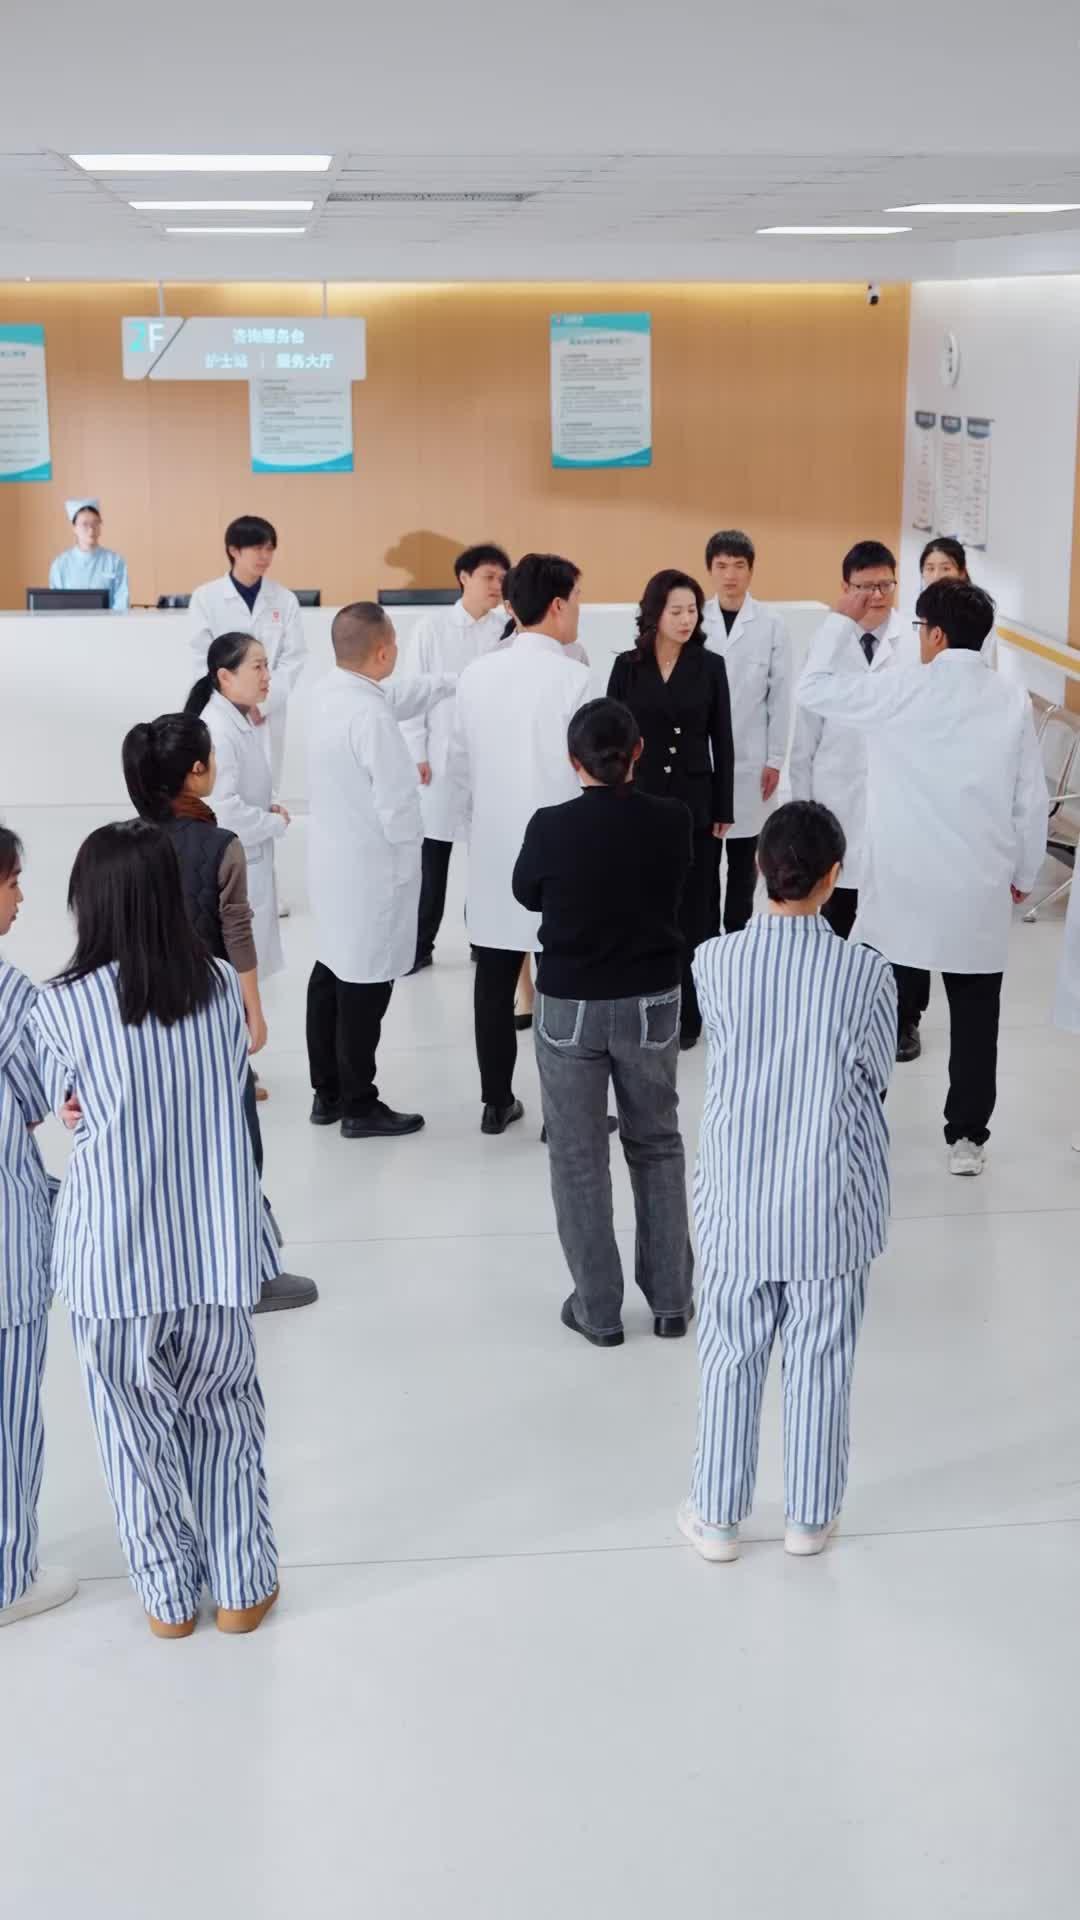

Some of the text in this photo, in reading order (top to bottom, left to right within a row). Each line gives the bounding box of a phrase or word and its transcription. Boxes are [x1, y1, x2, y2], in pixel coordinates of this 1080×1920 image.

[128, 322, 165, 352] 2F
[232, 328, 305, 345] 咨询服务台
[205, 353, 334, 369] 护士站 服务大厅
